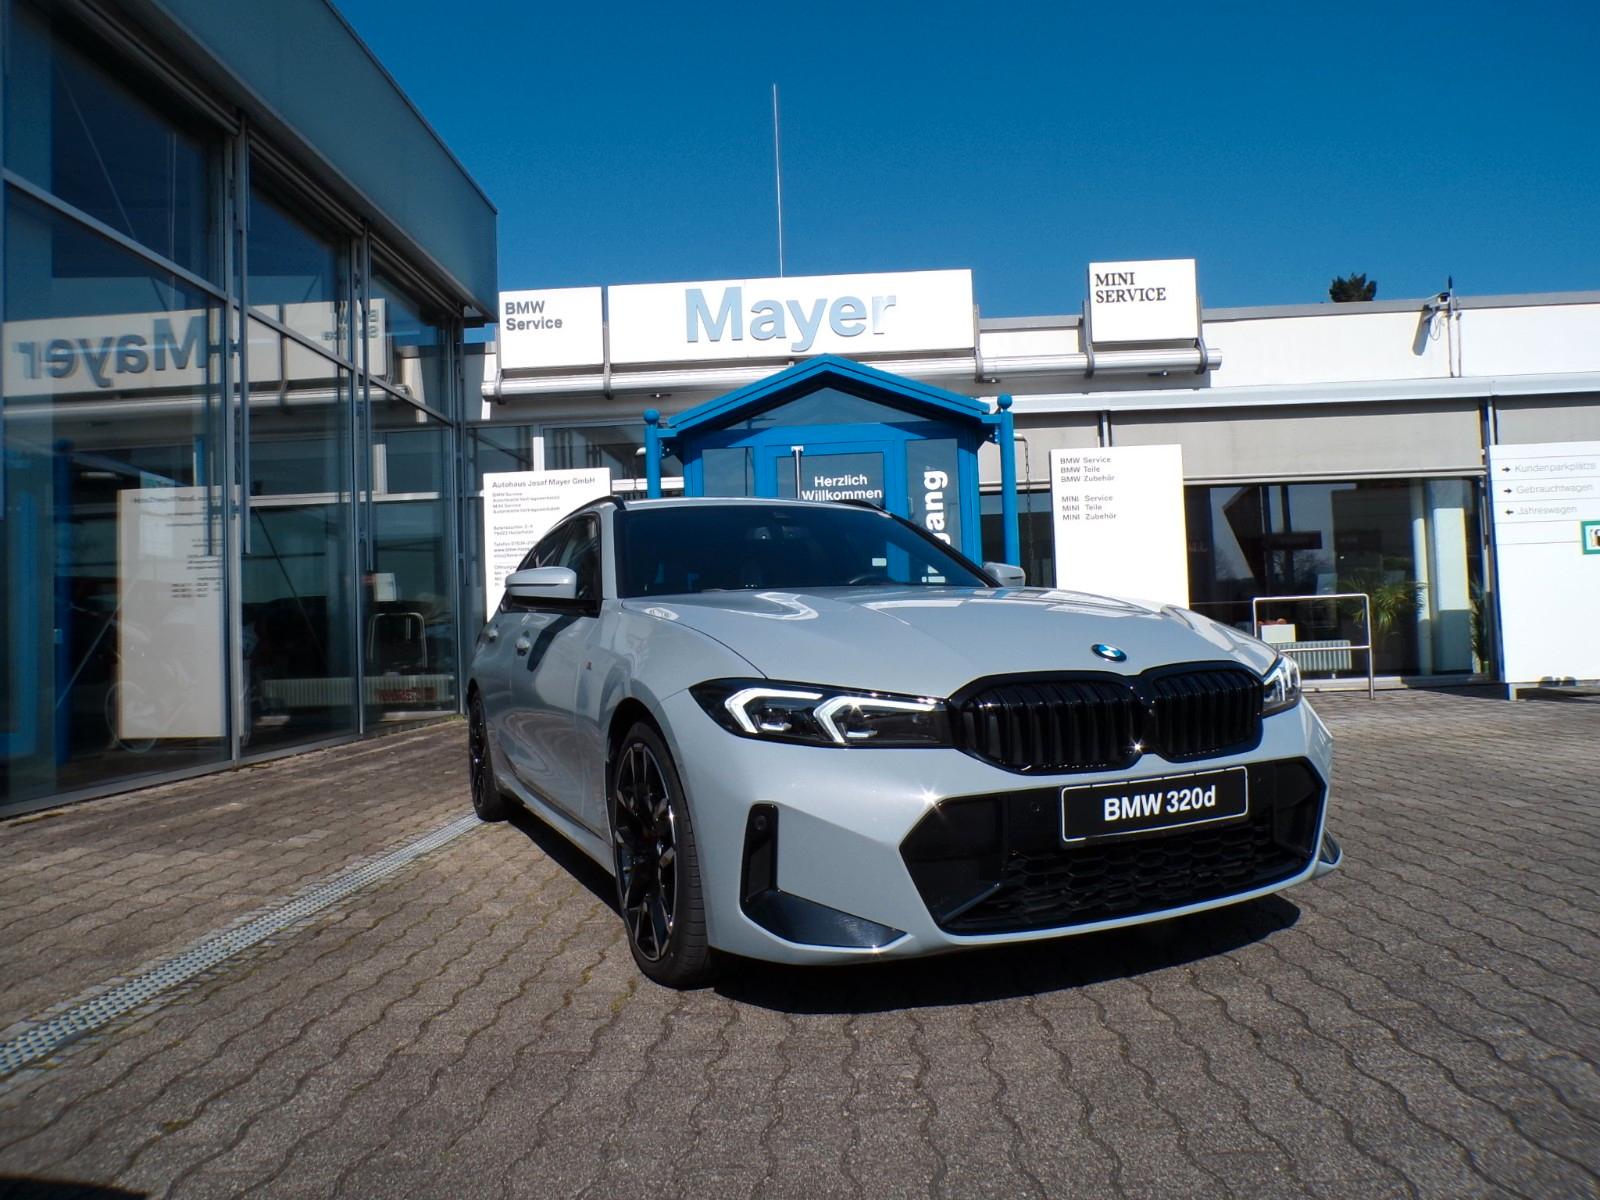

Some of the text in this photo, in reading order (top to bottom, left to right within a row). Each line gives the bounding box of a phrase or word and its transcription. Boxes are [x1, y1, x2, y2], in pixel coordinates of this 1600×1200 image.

[1095, 272, 1135, 287] MINI
[1096, 287, 1167, 304] SERVICE
[505, 300, 545, 315] BMW
[506, 316, 563, 331] Service
[684, 286, 897, 353] Mayer
[1060, 456, 1111, 465] BMW Service
[1060, 466, 1080, 474] BMW
[492, 480, 526, 489] Autohaus
[548, 478, 571, 488] Mayer
[572, 476, 596, 486] GmbH
[814, 474, 868, 487] Herzlich
[1061, 474, 1115, 483] BMW Zubehör
[801, 488, 883, 501] Willkommen
[1061, 494, 1113, 503] MINI Service
[1063, 512, 1117, 521] MINI Zubehör
[1104, 785, 1216, 821] BMW 320d
